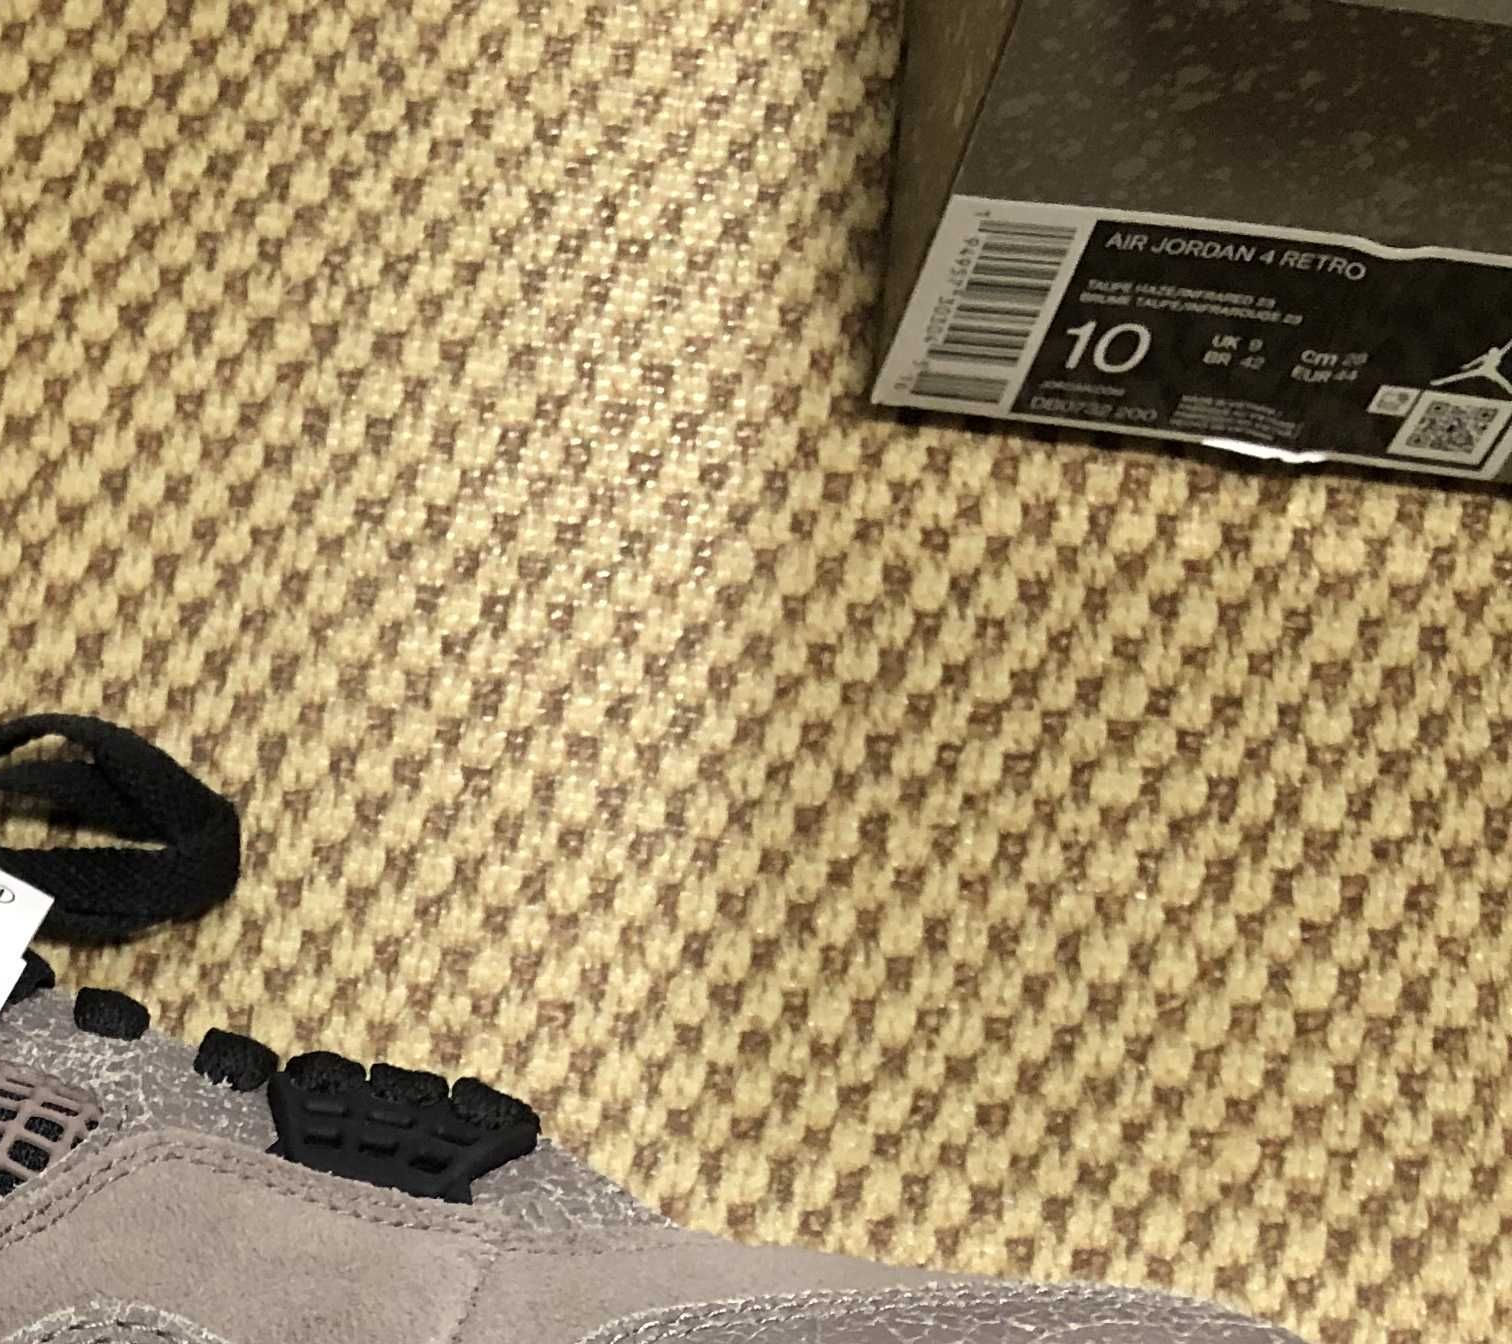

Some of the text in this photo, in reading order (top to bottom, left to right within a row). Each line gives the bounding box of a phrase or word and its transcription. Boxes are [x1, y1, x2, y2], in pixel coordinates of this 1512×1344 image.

[1105, 231, 1367, 281] AIR JORDAN 4 RETRO
[1064, 320, 1152, 374] 10
[1212, 334, 1242, 350] UK
[1202, 350, 1233, 367] BR
[1290, 364, 1333, 383] EUR
